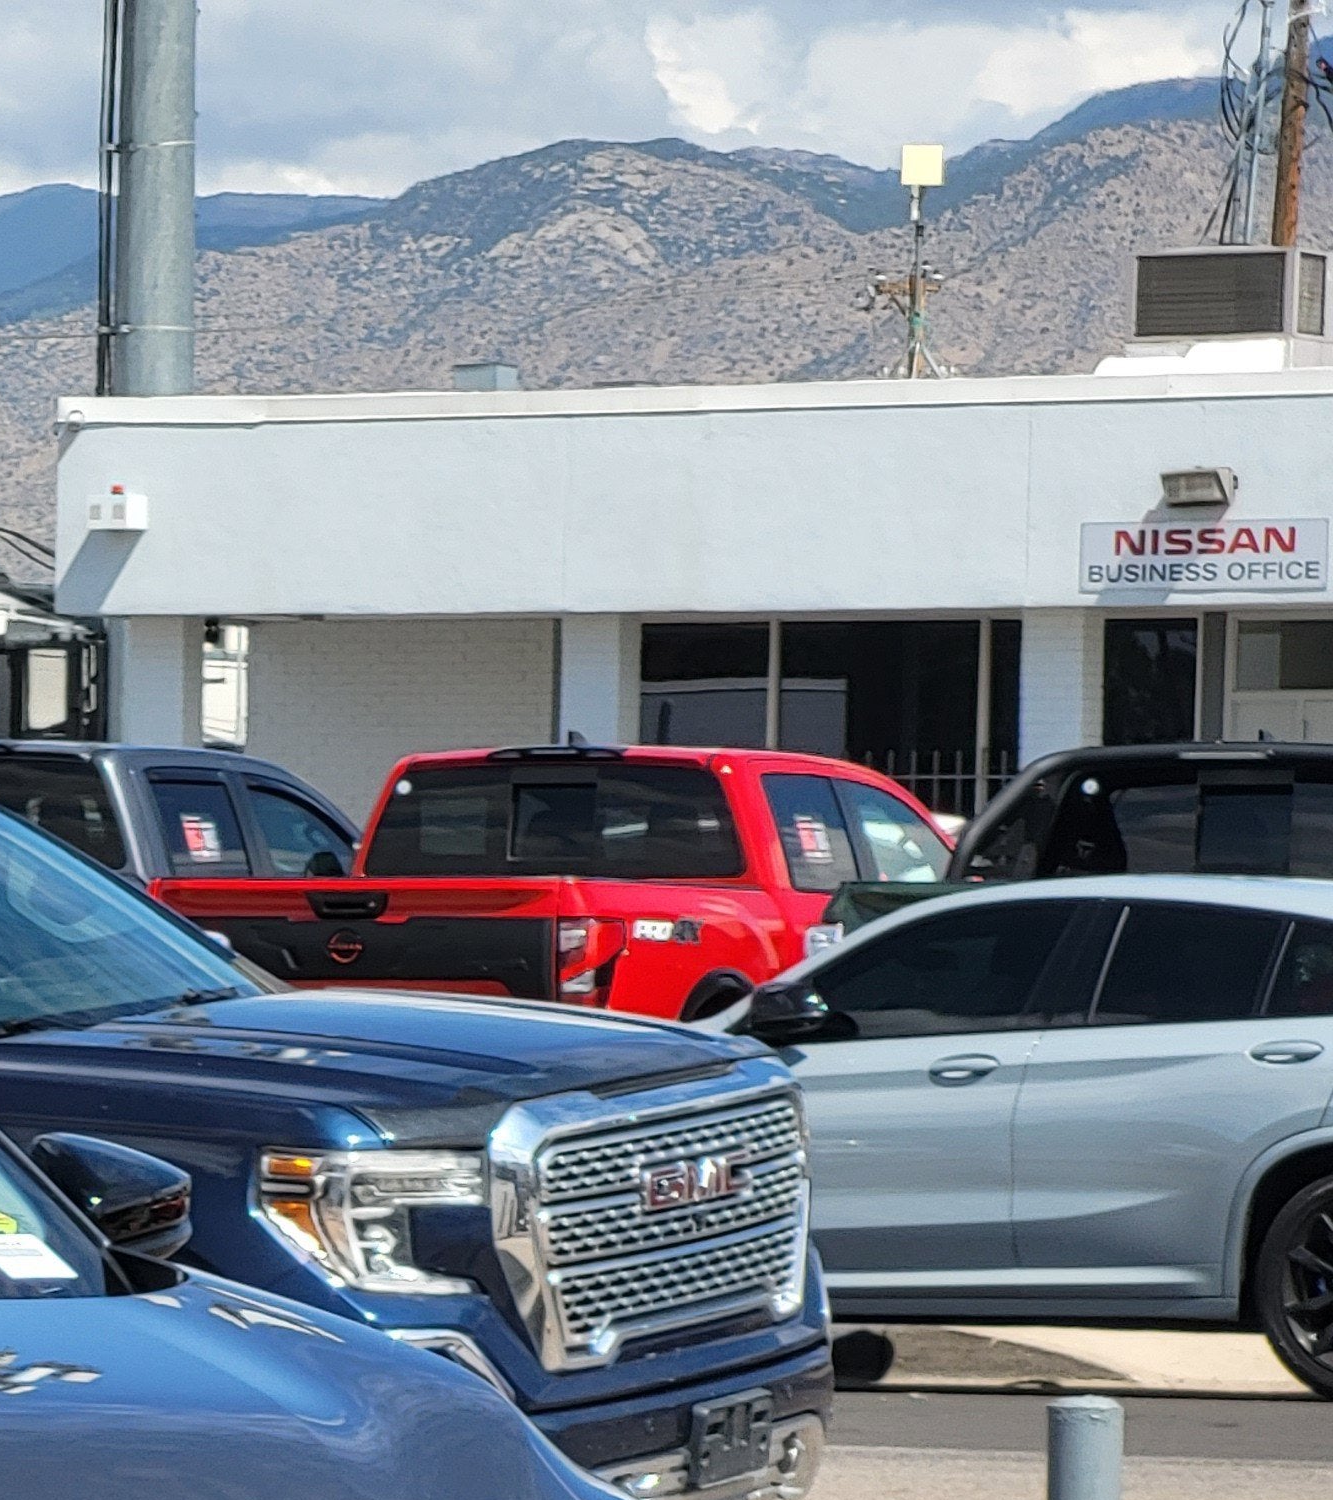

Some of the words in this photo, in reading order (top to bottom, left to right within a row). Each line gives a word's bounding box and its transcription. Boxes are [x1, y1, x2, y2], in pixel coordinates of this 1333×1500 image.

[1113, 526, 1296, 556] NISSAN
[1087, 562, 1218, 583] BUSINESS
[1227, 561, 1321, 581] OFFICE
[640, 1150, 753, 1212] GMC
